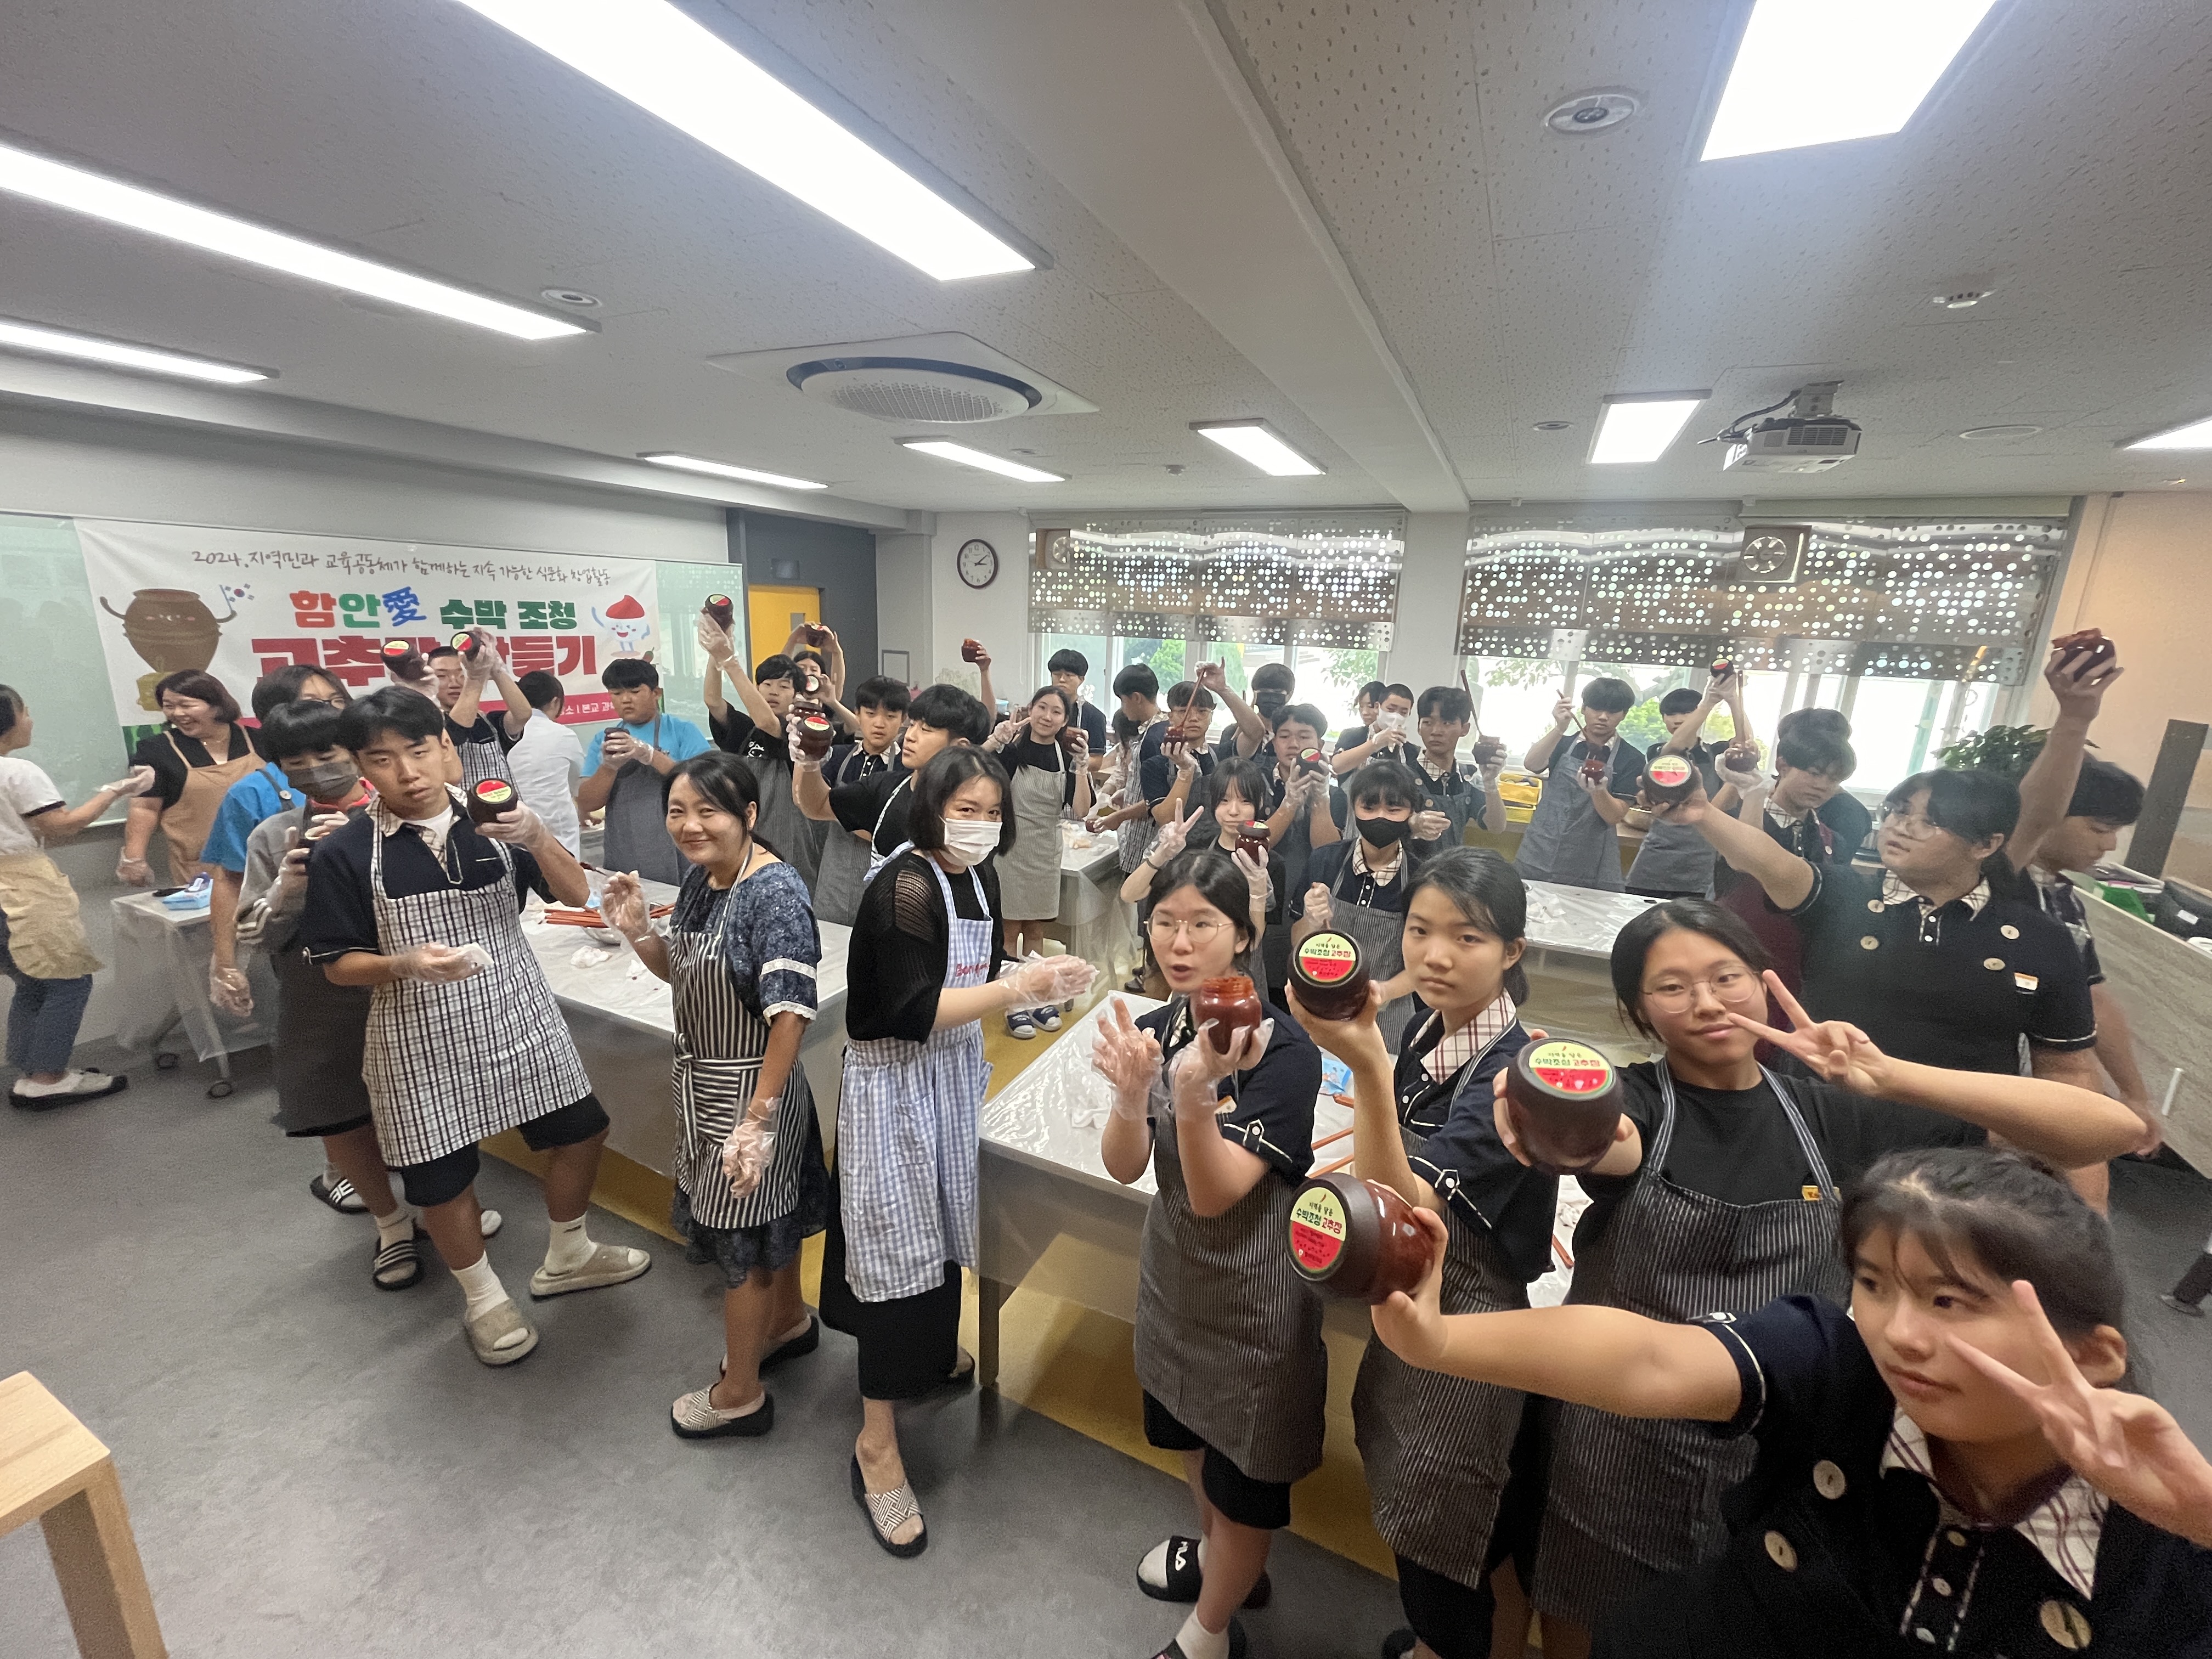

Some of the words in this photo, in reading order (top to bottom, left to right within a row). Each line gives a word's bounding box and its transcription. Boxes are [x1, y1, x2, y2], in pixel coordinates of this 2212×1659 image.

[326, 551, 408, 575] 교육공동체가
[411, 557, 471, 578] 함께하는
[472, 561, 495, 581] 지속
[499, 565, 533, 580] 가능한
[536, 566, 568, 583] 식문화
[571, 567, 611, 586] 창업활동
[439, 599, 507, 630] 수박
[517, 601, 577, 629] 조청
[251, 635, 441, 687] 고추
[1296, 1207, 1322, 1226] 수박조청
[1321, 1217, 1342, 1234] 고추장
